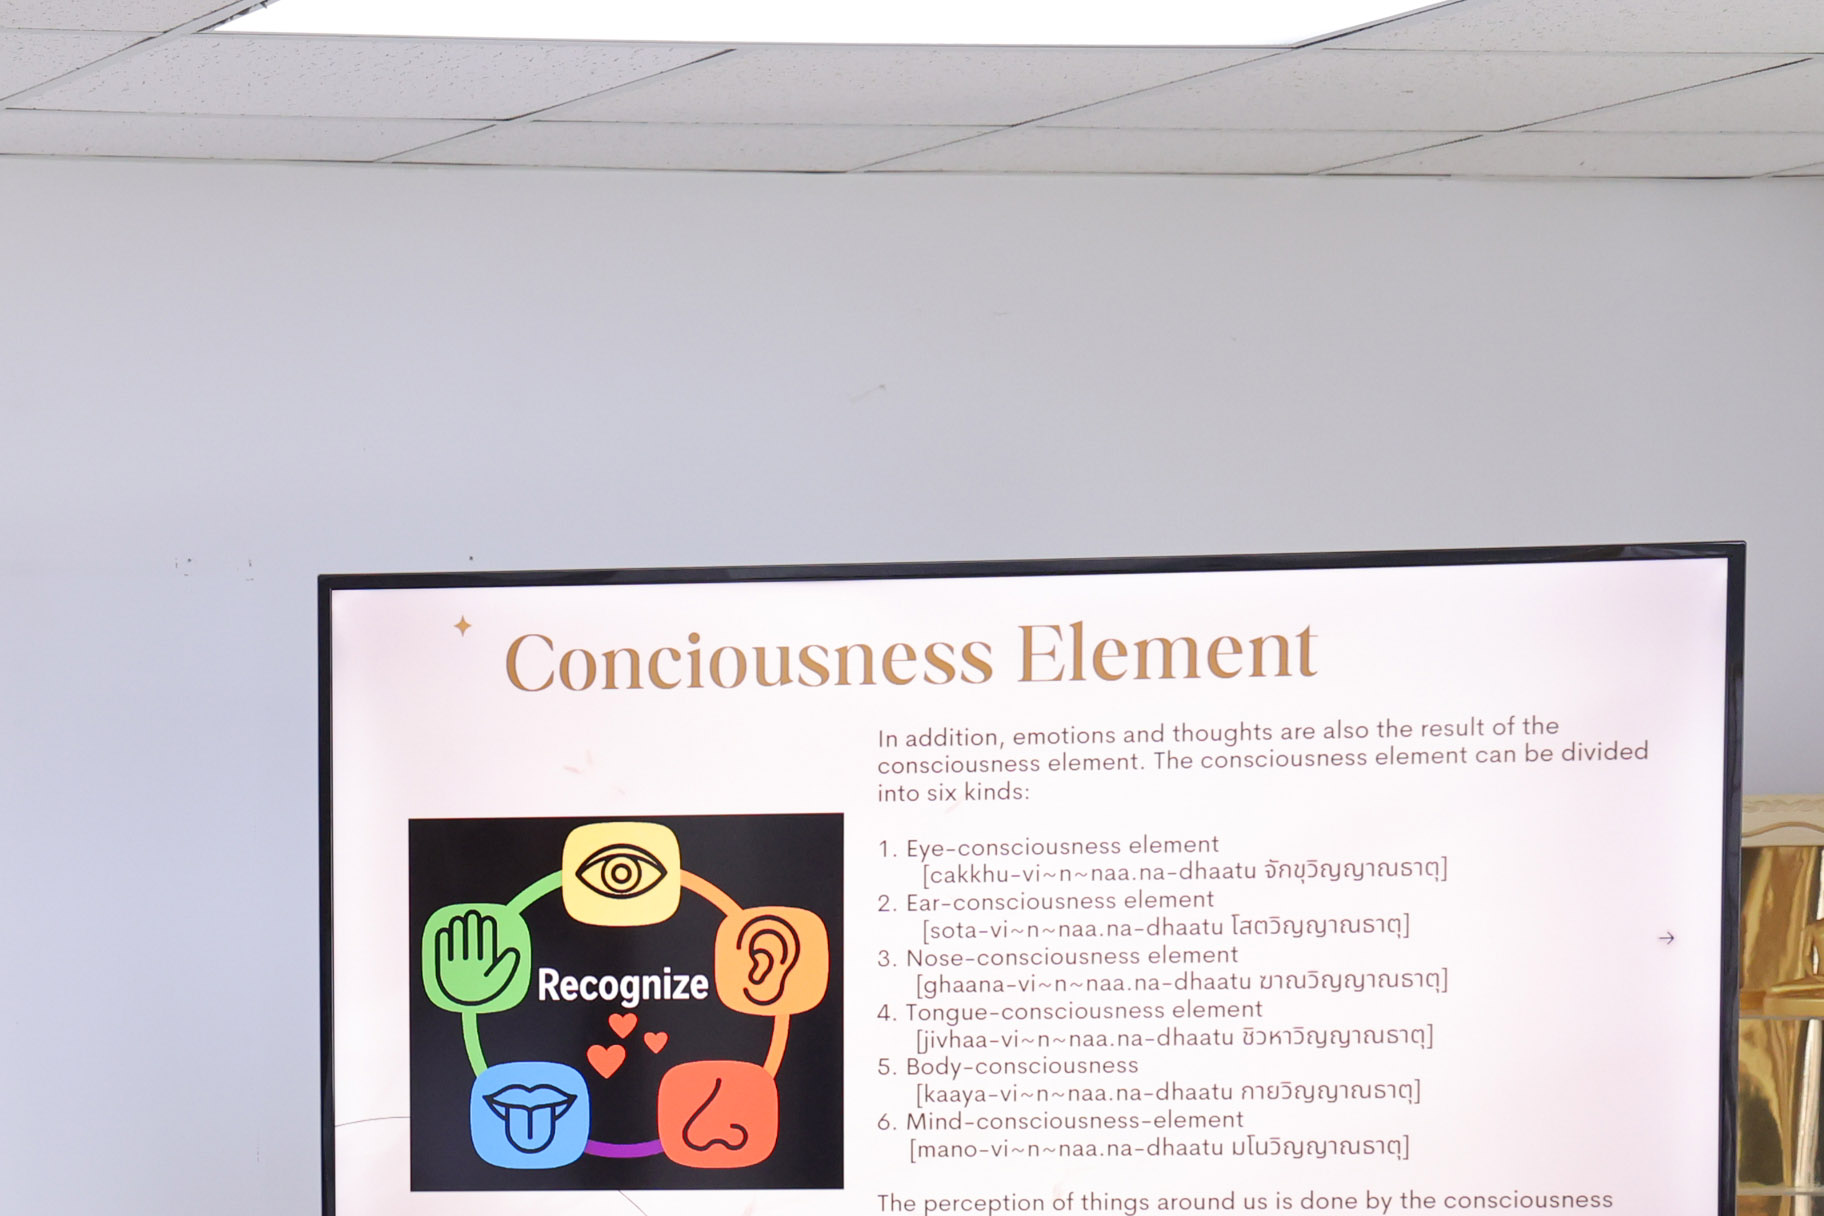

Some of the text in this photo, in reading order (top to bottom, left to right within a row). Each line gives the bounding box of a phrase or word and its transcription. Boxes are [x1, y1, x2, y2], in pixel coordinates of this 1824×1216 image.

[505, 619, 1320, 693] Conciousness Element
[878, 714, 1560, 750] In addition, emotions and thoughts are also the result of the
[877, 738, 1649, 775] consciousness element. The consciousness element can be divided
[878, 779, 1030, 803] into six kinds:
[879, 833, 1220, 864] 1. Eye-consciousness element
[922, 859, 1257, 891] [cakkhu-vi~n~naa.na-dhaatu
[877, 888, 1215, 913] 2. Ear-consciousness element
[922, 915, 1224, 946] [sota-vi~n~naa.na-dhaatu
[877, 943, 1239, 968] 3. Nose-consciousness element
[538, 966, 710, 1009] Recognize
[916, 970, 1252, 1000] [ghaana-vi~n~naa.na-dhaatu
[876, 997, 1264, 1028] 4. Tongue-consciousness element
[916, 1025, 1234, 1056] [jivhaa-vi~n~naa.na-dhaatu
[877, 1054, 1139, 1082] 5. Body-consciousness
[916, 1080, 1233, 1110] [kaaya-vi~n~naa.na-dhaatu
[876, 1108, 1244, 1132] 6. Mind-consciousness-element
[909, 1136, 1224, 1165] [mano-vi~n~naa.na-dhaatu
[876, 1191, 917, 1213] The
[1051, 1190, 1075, 1212] of
[1080, 1190, 1150, 1216] things
[1156, 1189, 1235, 1211] around
[1243, 1196, 1269, 1211] us
[1275, 1190, 1294, 1211] is
[1299, 1189, 1359, 1211] done
[1365, 1189, 1393, 1216] by
[1399, 1188, 1437, 1210] the
[1443, 1189, 1614, 1210] consciousness
